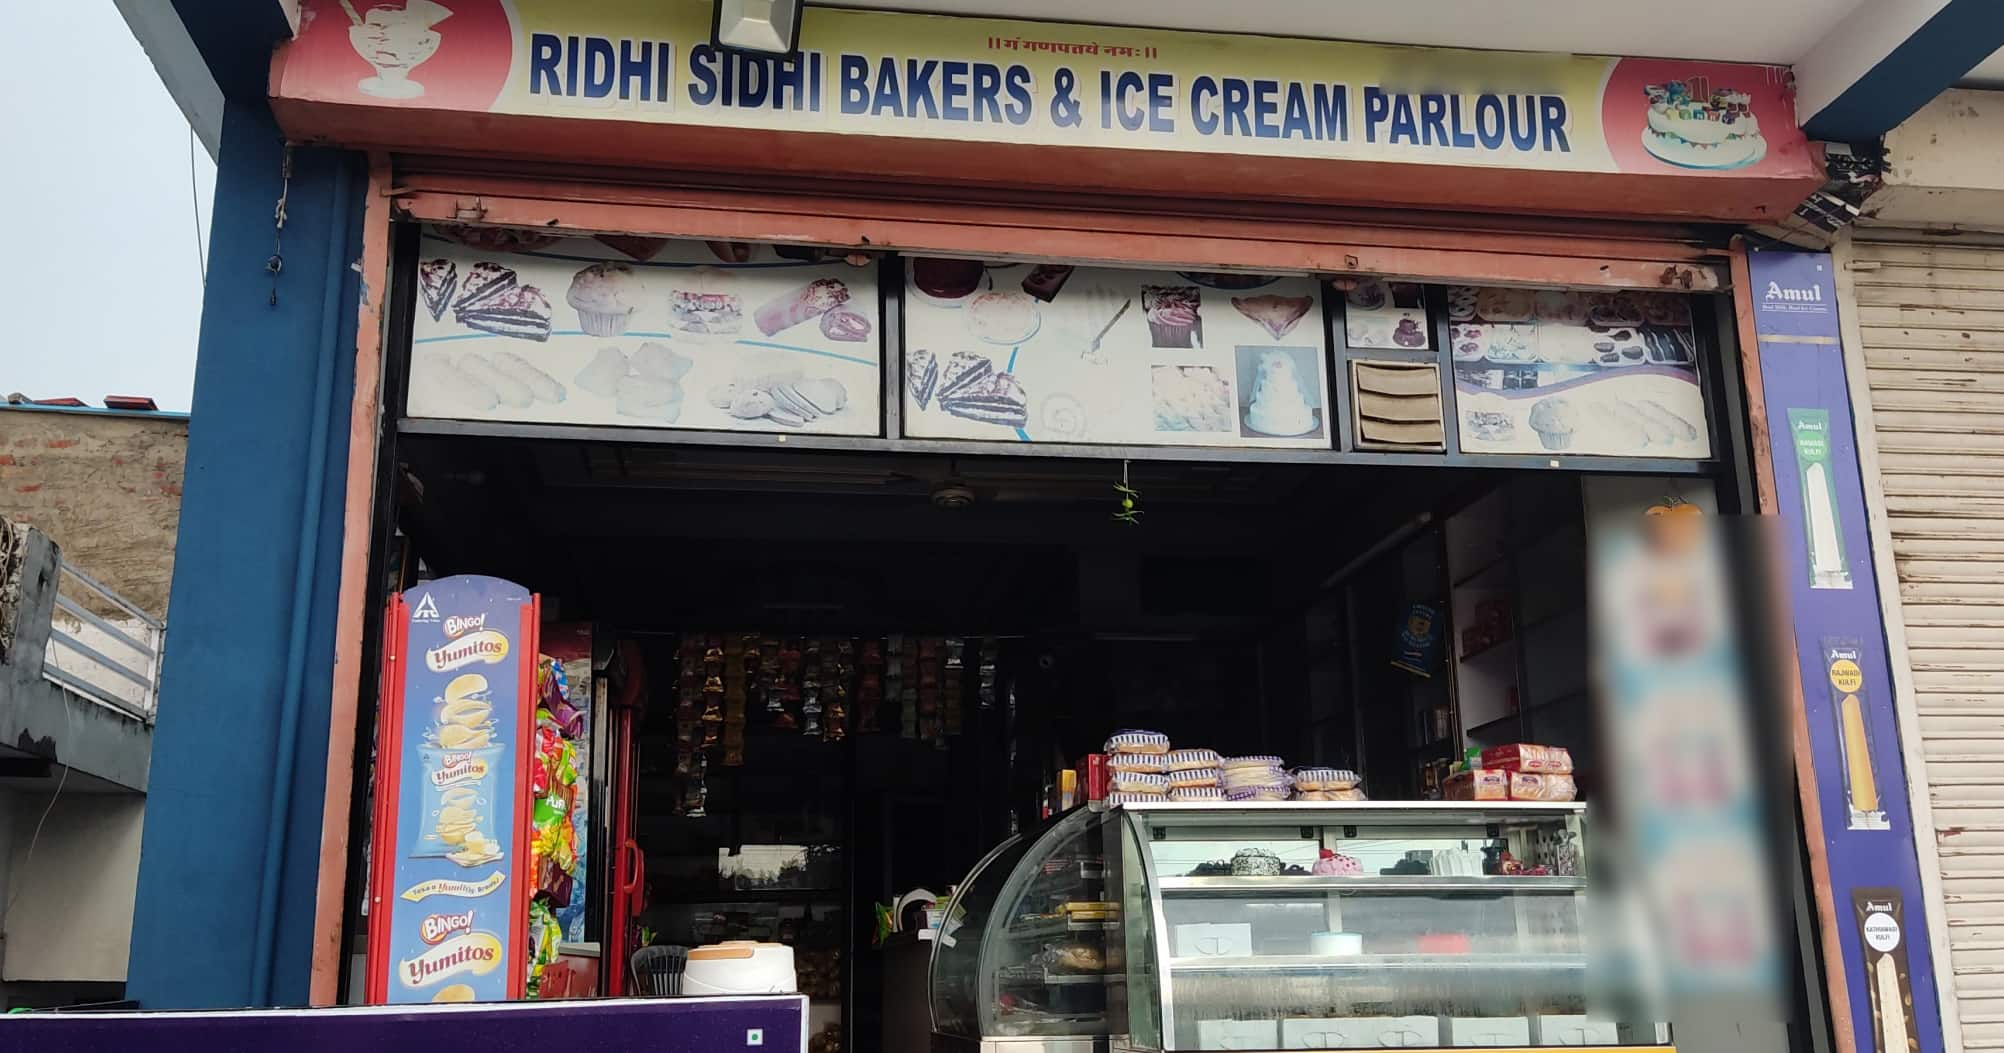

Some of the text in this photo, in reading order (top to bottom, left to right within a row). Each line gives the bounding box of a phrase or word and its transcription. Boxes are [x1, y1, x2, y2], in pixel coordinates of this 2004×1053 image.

[530, 33, 1571, 152] RIDHI SIDHI BAKERS & ICE CREAM PARLOUR
[1765, 281, 1821, 303] Amul
[1798, 420, 1822, 430] Amul
[445, 613, 486, 634] BINGO!
[434, 641, 503, 669] Yumitos
[1831, 649, 1857, 659] Amul
[436, 763, 485, 784] Yumitos
[1865, 901, 1892, 911] Amul
[424, 910, 473, 939] BINGO!
[408, 946, 494, 984] Yumitos
